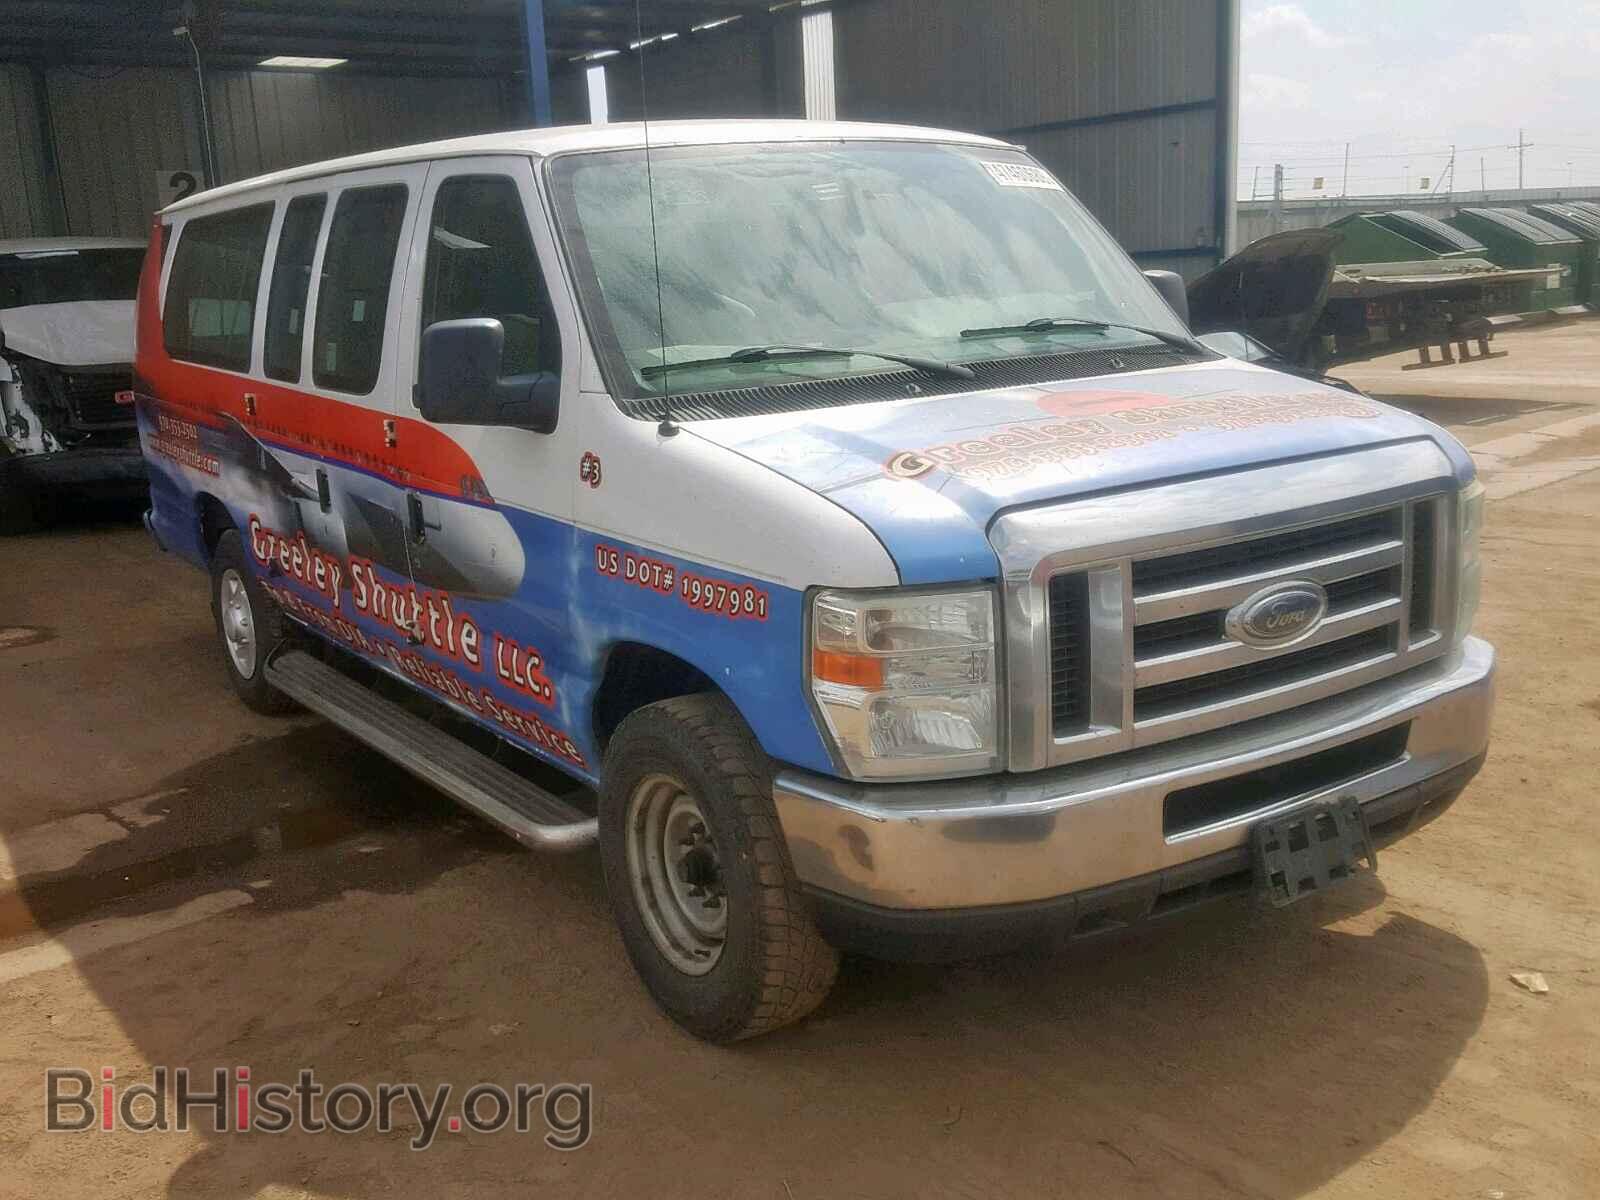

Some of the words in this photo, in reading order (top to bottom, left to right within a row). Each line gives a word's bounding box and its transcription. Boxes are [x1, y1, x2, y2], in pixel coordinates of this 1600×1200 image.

[169, 171, 197, 203] 2
[580, 455, 600, 486] #3
[250, 516, 343, 609] Greeley
[350, 560, 481, 666] Shuttle
[496, 636, 553, 698] LLC.
[596, 546, 618, 575] US
[625, 557, 673, 593] DOT#
[681, 575, 767, 618] 1997981
[1264, 600, 1307, 630] Ford
[386, 643, 484, 712] Reliable
[484, 693, 583, 764] Service
